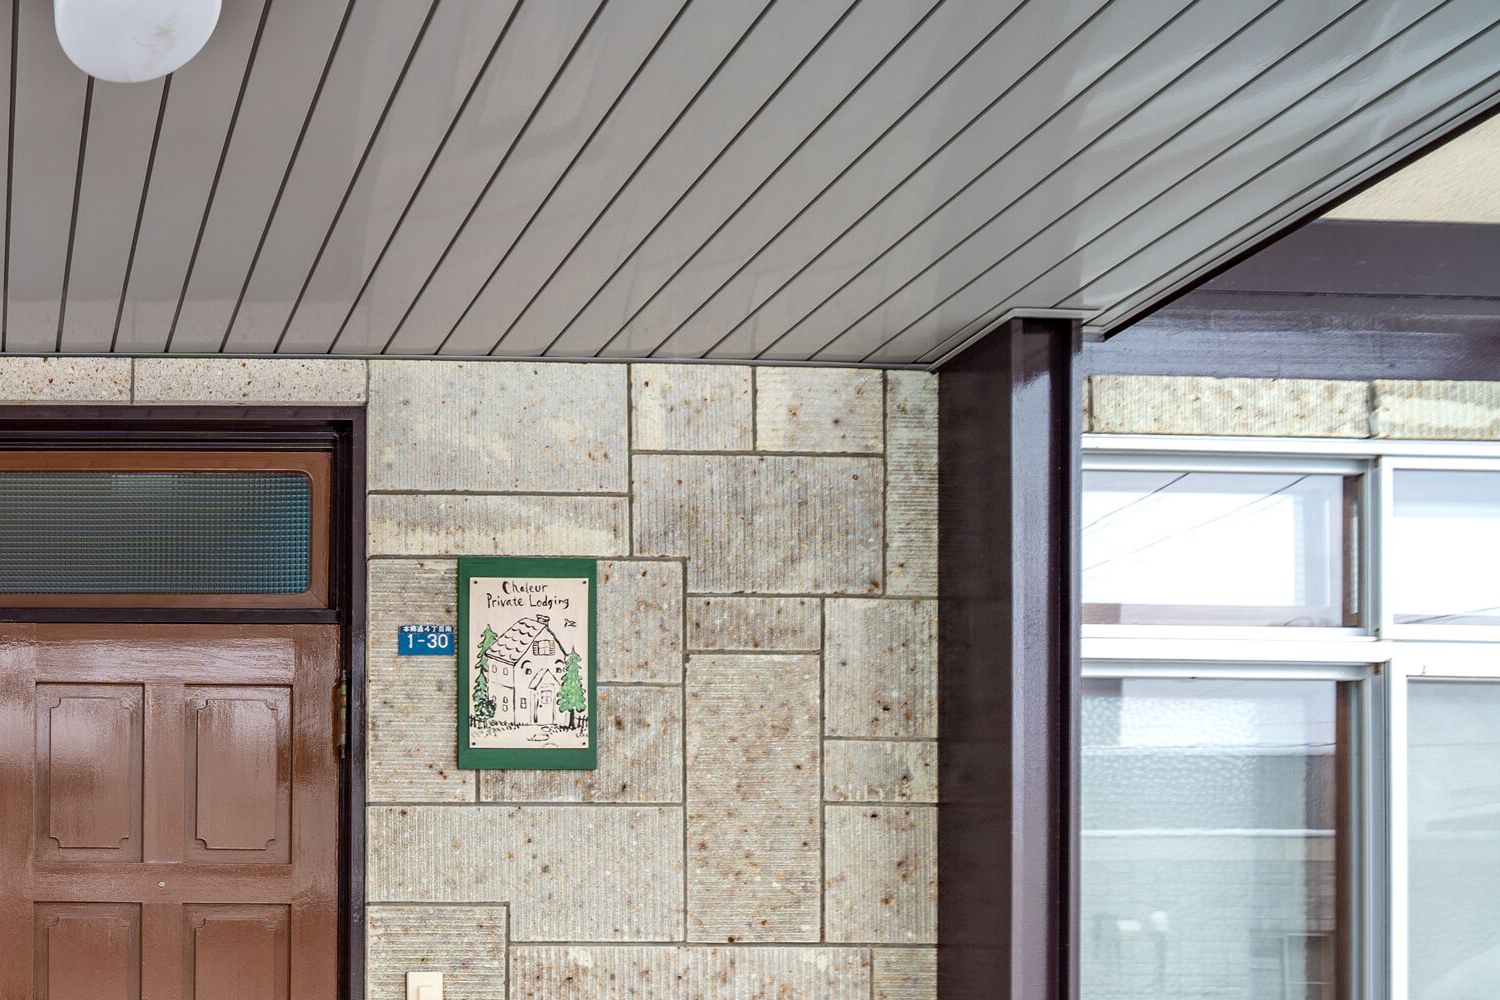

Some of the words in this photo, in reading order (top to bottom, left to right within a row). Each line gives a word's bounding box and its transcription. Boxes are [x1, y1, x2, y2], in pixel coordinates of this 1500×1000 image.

[502, 581, 548, 594] Chaleur
[486, 593, 525, 608] Private
[529, 592, 570, 610] Lodging
[408, 634, 448, 649] 1-30
